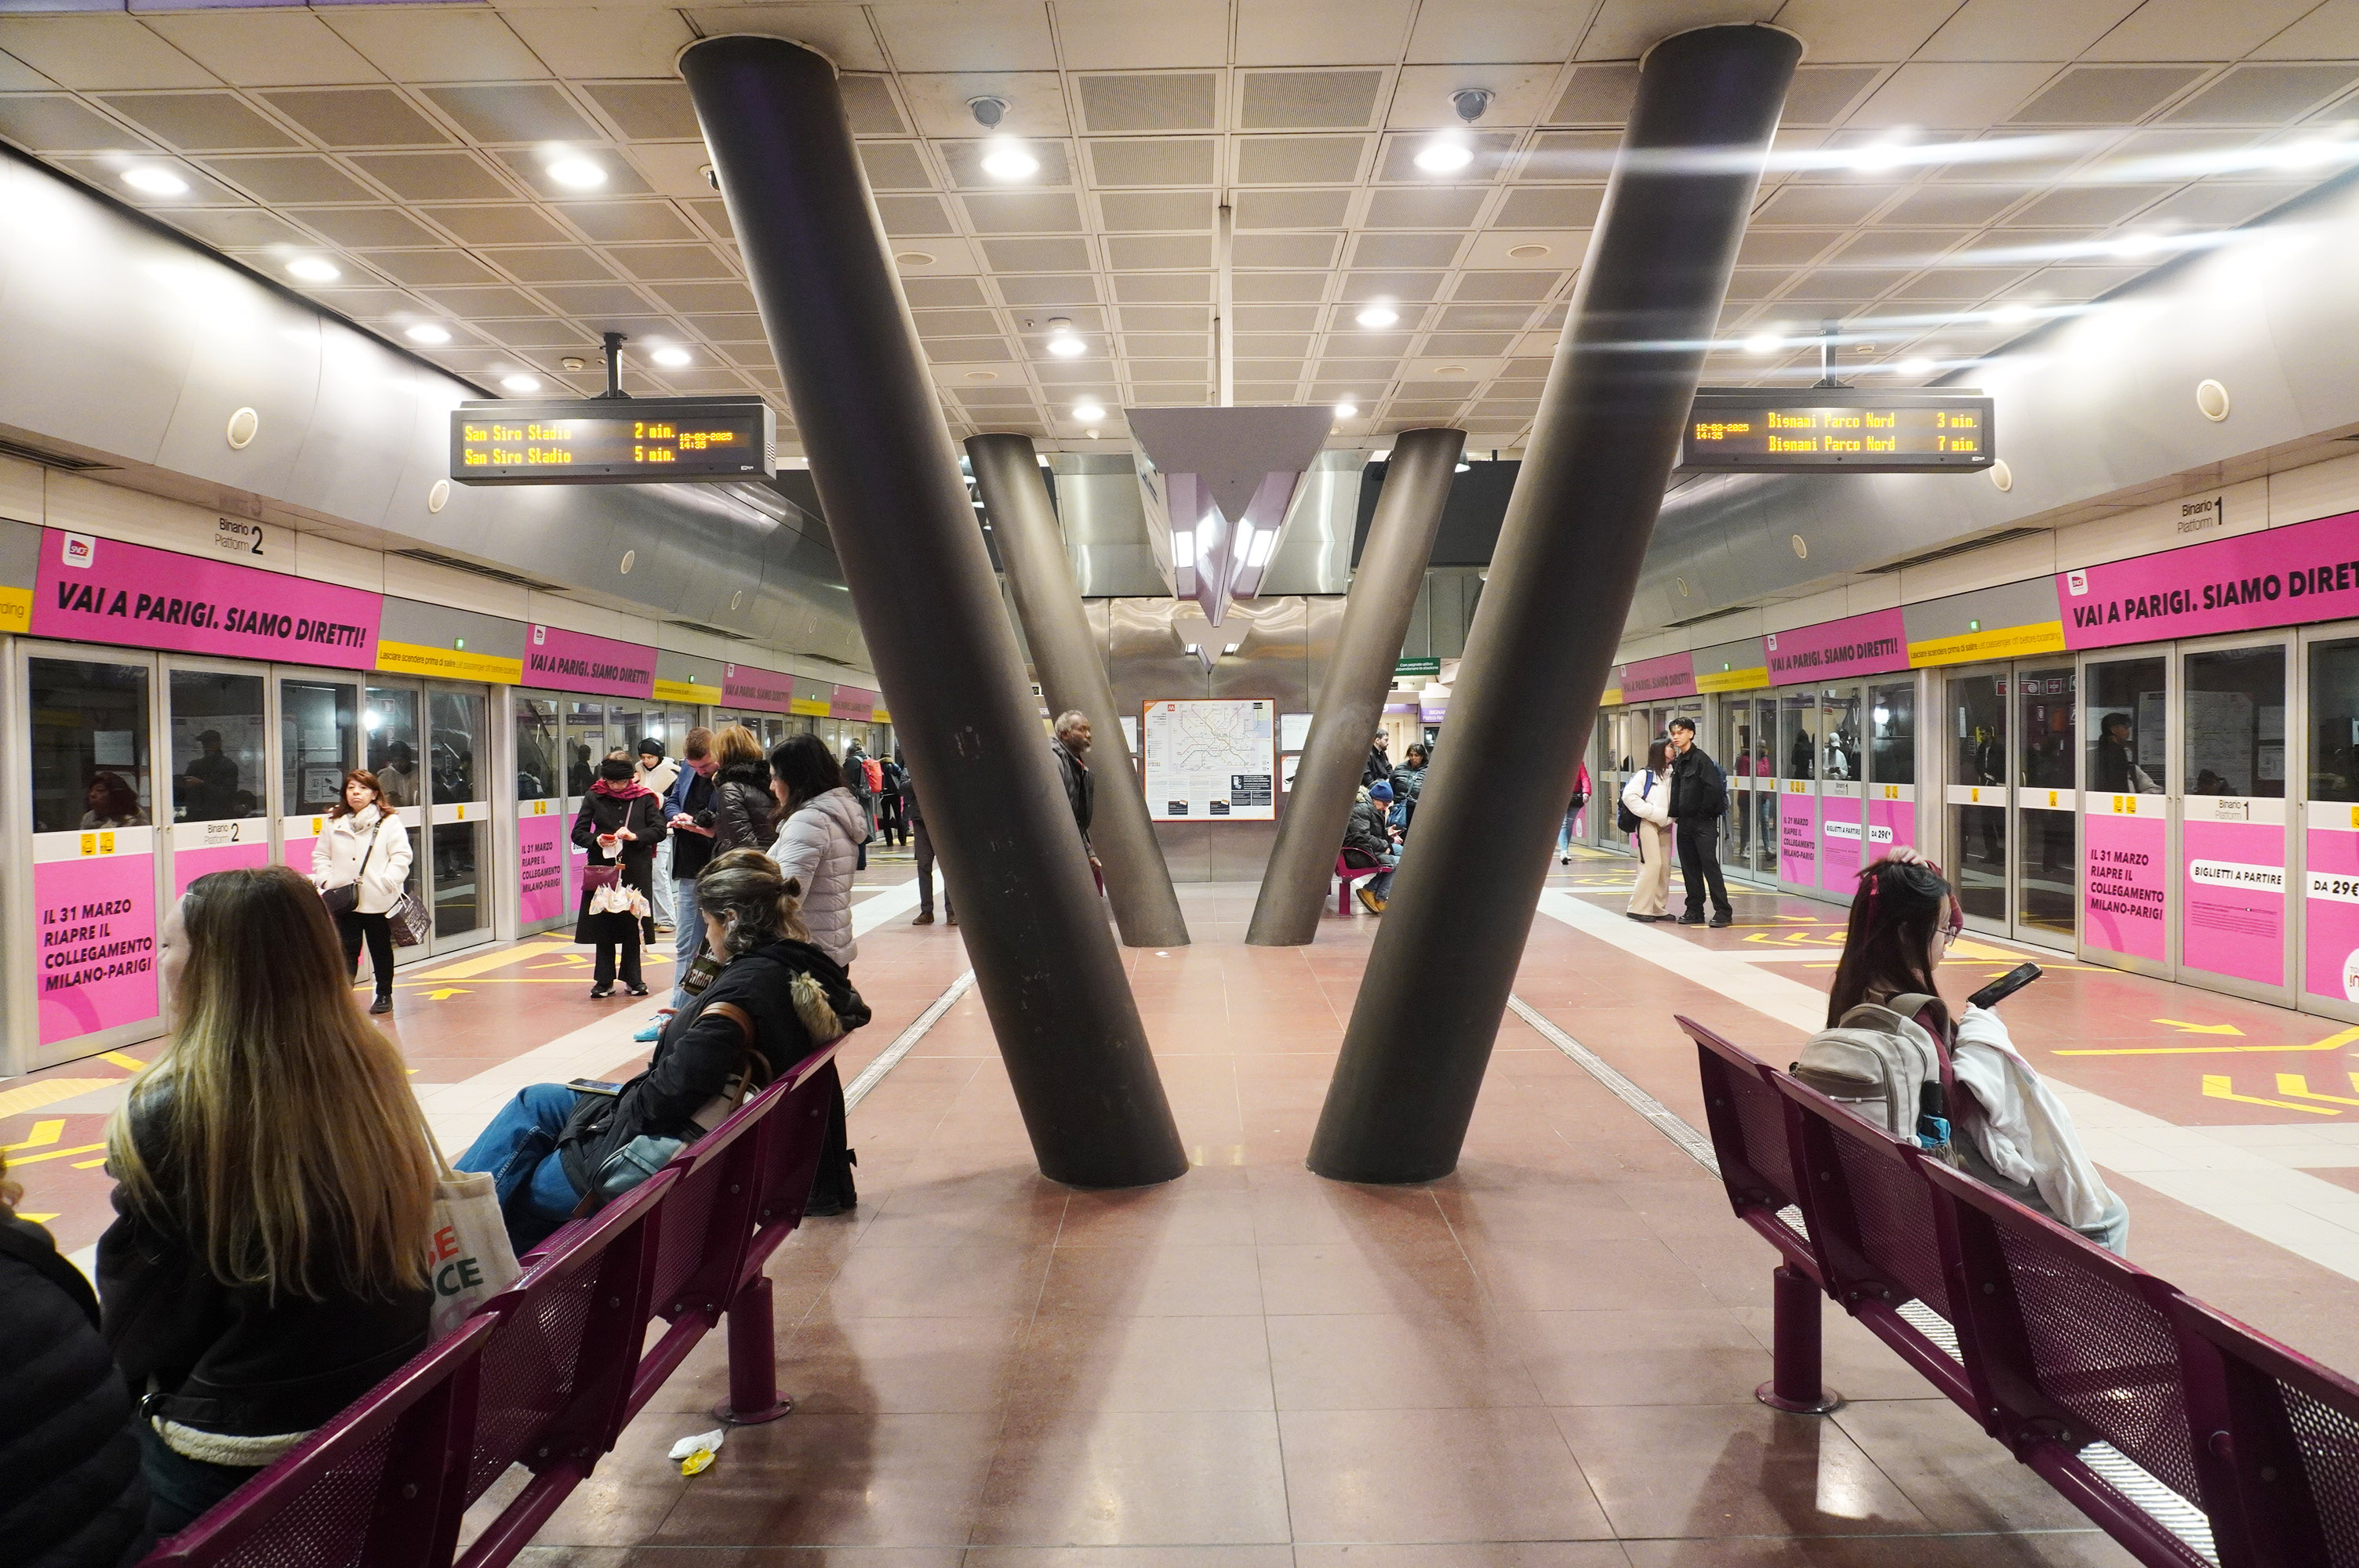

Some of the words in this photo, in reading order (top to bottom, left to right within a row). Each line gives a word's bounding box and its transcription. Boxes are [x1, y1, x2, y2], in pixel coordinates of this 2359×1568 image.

[1696, 423, 1750, 432] 12-03-2025
[1768, 412, 1816, 428] Bignami
[1825, 412, 1860, 428] Parco
[1866, 412, 1895, 428] Nord
[1937, 412, 1946, 428] 3
[1950, 414, 1978, 428] min.
[465, 425, 488, 441] San
[493, 425, 522, 441] Siro
[528, 424, 571, 441] Stadio
[634, 423, 643, 438] 2
[649, 424, 675, 438] min.
[679, 433, 733, 441] 12-03-2025
[1768, 435, 1817, 452] Bignami
[1825, 436, 1860, 452] Parco
[1866, 436, 1896, 452] Nord
[1938, 436, 1946, 452] 7
[1951, 437, 1978, 452] min.
[465, 448, 488, 465] San
[493, 448, 522, 464] Siro
[528, 448, 571, 463] Stadio
[634, 446, 643, 462] 5
[649, 447, 675, 462] min.
[2182, 499, 2212, 517] Binario
[2215, 495, 2223, 525] 1
[2177, 516, 2213, 534] Platform
[214, 533, 249, 553] Platform
[219, 517, 249, 535] Binario
[251, 526, 264, 555] 2
[69, 545, 89, 556] SNCF
[2073, 604, 2103, 628] VAI
[2107, 601, 2121, 623] A
[2125, 589, 2197, 621] PARIGI.
[2203, 574, 2281, 610] SIAMO
[58, 581, 106, 614] VAI
[107, 590, 127, 617] A
[133, 593, 219, 630] PARIGI.
[224, 607, 292, 639] SIAMO
[295, 618, 367, 648] DIRETTI!
[380, 651, 401, 661] Lasciare
[402, 654, 424, 664] scendere
[424, 657, 438, 666] prima
[1771, 657, 1784, 672] VAI
[1786, 655, 1793, 670] A
[1793, 651, 1823, 670] PARIGI.
[1824, 645, 1855, 665] SIAMO
[1857, 637, 1899, 660] DIRETTI!
[1910, 650, 1927, 659] Lasciare
[1928, 648, 1947, 657] scendere
[1947, 645, 1960, 655] prima
[1965, 643, 1978, 652] salire
[530, 653, 548, 672] VAI
[548, 657, 555, 673] A
[557, 658, 590, 677] PARIGI.
[591, 662, 618, 681] SIAMO
[619, 667, 650, 684] DIRETTI!
[2215, 810, 2241, 820] Platform
[2219, 800, 2241, 809] Binario
[2244, 800, 2249, 820] 1
[1794, 818, 1808, 826] MARZO
[1826, 825, 1841, 833] BIGLIETTI
[208, 824, 228, 833] Binario
[231, 822, 239, 842] 2
[1783, 827, 1797, 836] RIAPRE
[522, 845, 526, 854] IL
[528, 844, 533, 853] 31
[535, 842, 553, 851] MARZO
[1783, 837, 1815, 850] COLLEGAMENTO
[522, 857, 540, 867] RIAPRE
[541, 855, 545, 864] IL
[1783, 849, 1815, 860] MILANO-PARIGI
[2091, 849, 2098, 860] IL
[2100, 850, 2111, 862] 31
[2114, 851, 2149, 866] MARZO
[522, 866, 561, 880] COLLEGAMENTO
[2091, 866, 2122, 880] RIAPRE
[2125, 869, 2132, 881] IL
[2194, 866, 2233, 880] BIGLIETTI
[2235, 872, 2242, 880] A
[2245, 873, 2281, 885] PARTIRE
[2314, 880, 2328, 891] DA
[522, 878, 561, 893] MILANO-PARIGI
[2091, 882, 2165, 902] COLLEGAMENTO
[43, 909, 56, 924] IL
[60, 906, 77, 922] 31
[82, 899, 131, 919] MARZO
[2091, 898, 2163, 920] MILANO-PARIGI
[44, 925, 96, 947] RIAPRE
[100, 923, 110, 938] IL
[45, 937, 152, 969] COLLEGAMENTO
[45, 957, 151, 992] MILANO-PARIGI
